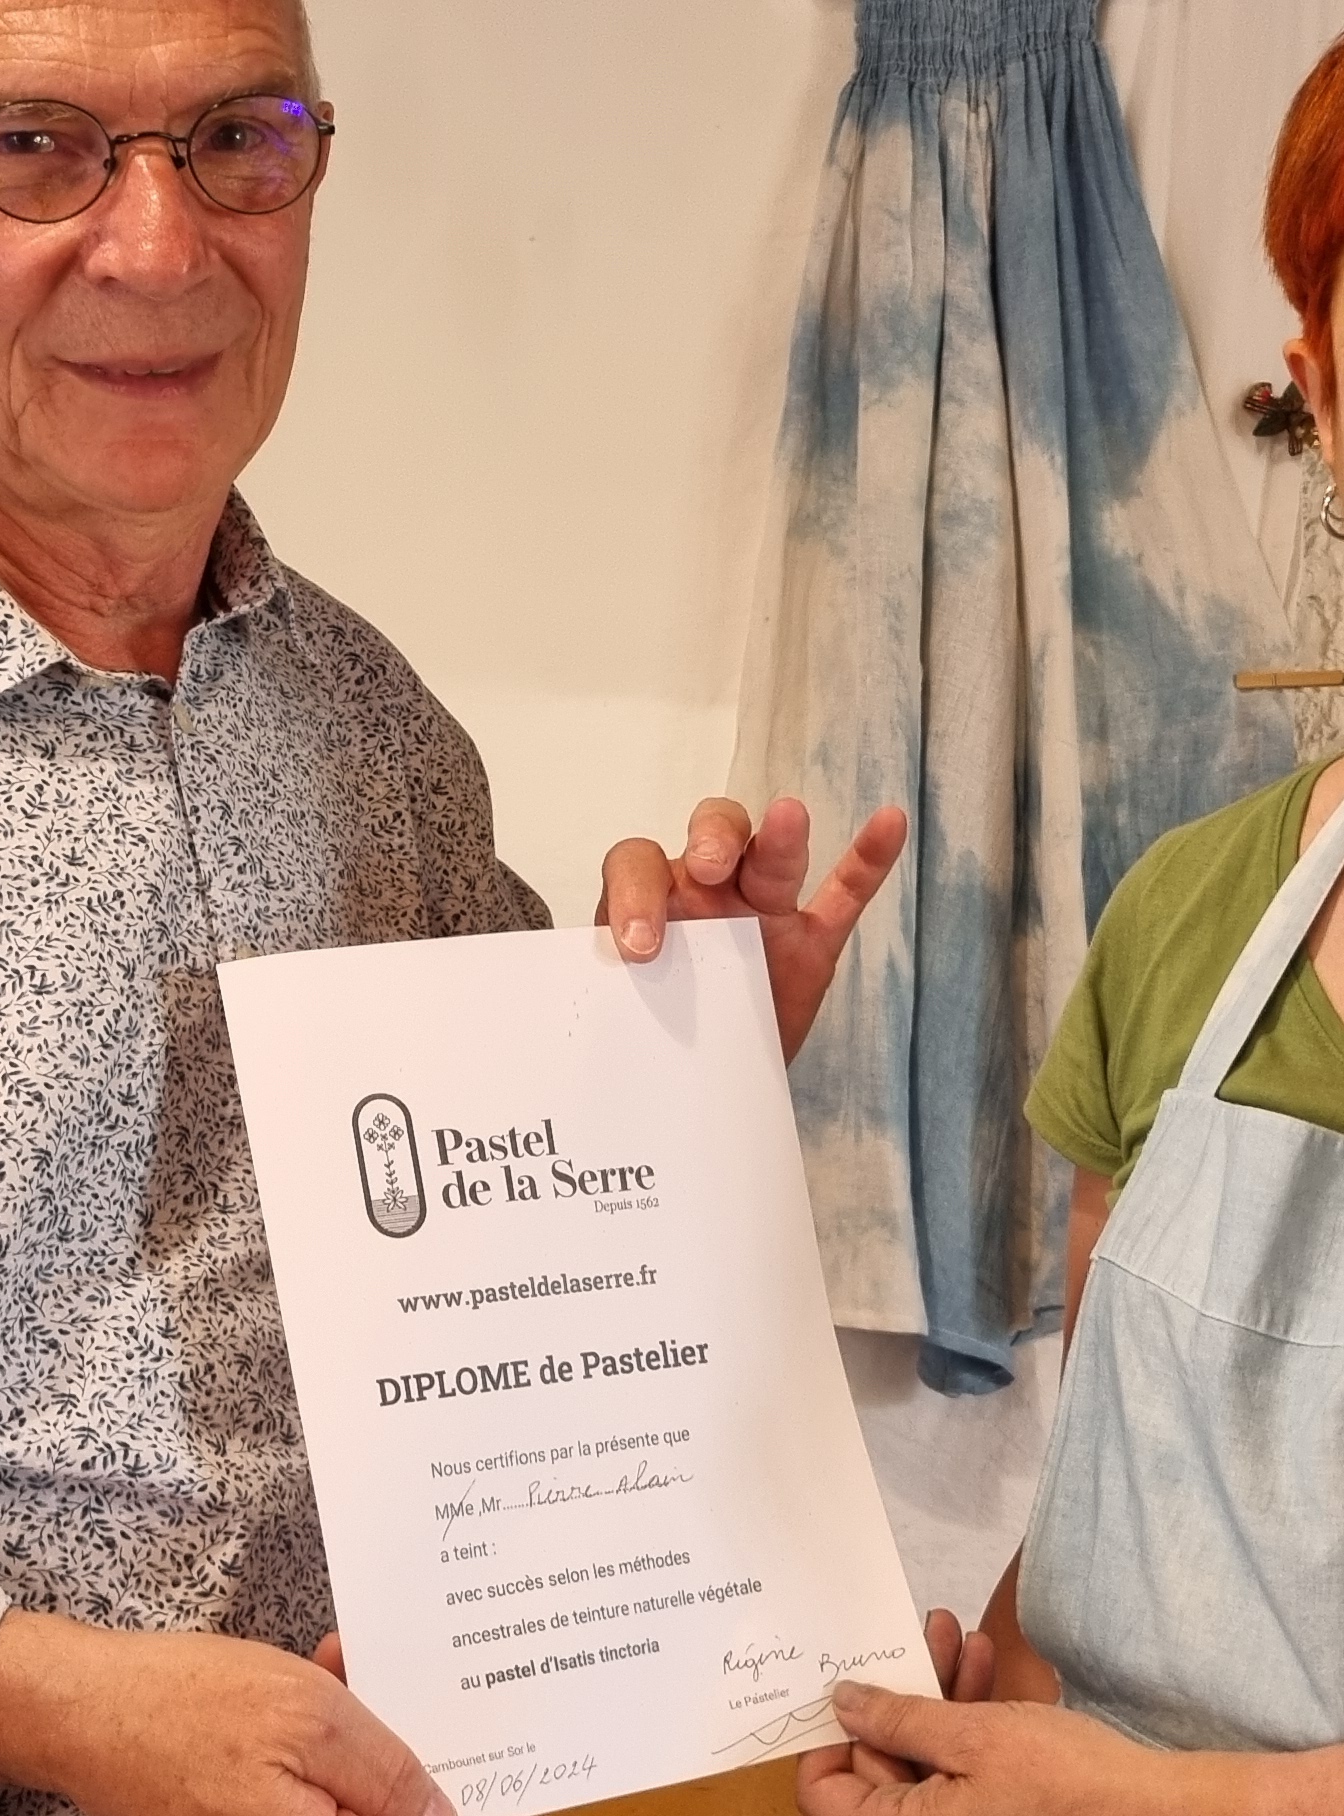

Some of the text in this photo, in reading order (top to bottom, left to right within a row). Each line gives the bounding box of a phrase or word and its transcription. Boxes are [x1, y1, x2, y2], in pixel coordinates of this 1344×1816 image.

[431, 1118, 559, 1167] Pastel
[441, 1158, 656, 1209] de la Serre
[594, 1196, 660, 1215] Depuis 1562
[397, 1264, 658, 1314] www.pasteldelaserre.fr
[375, 1339, 709, 1407] DIPLOME de Pastelier
[431, 1428, 691, 1479] Nous certifions par la présente que
[527, 1459, 695, 1508] Pierre Alain
[440, 1550, 450, 1564] a
[453, 1540, 489, 1561] teint
[446, 1550, 691, 1606] avec succès selon les méthodes
[451, 1577, 763, 1649] ancestrales de teinture naturelle végétale
[460, 1637, 661, 1691] au pastel d'Isatis tinctoria
[818, 1647, 906, 1688] Bruno
[728, 1687, 790, 1711] Le Pastelier
[423, 1742, 536, 1776] Cambounet sur Sor le
[460, 1753, 598, 1811] 08/06/2024
